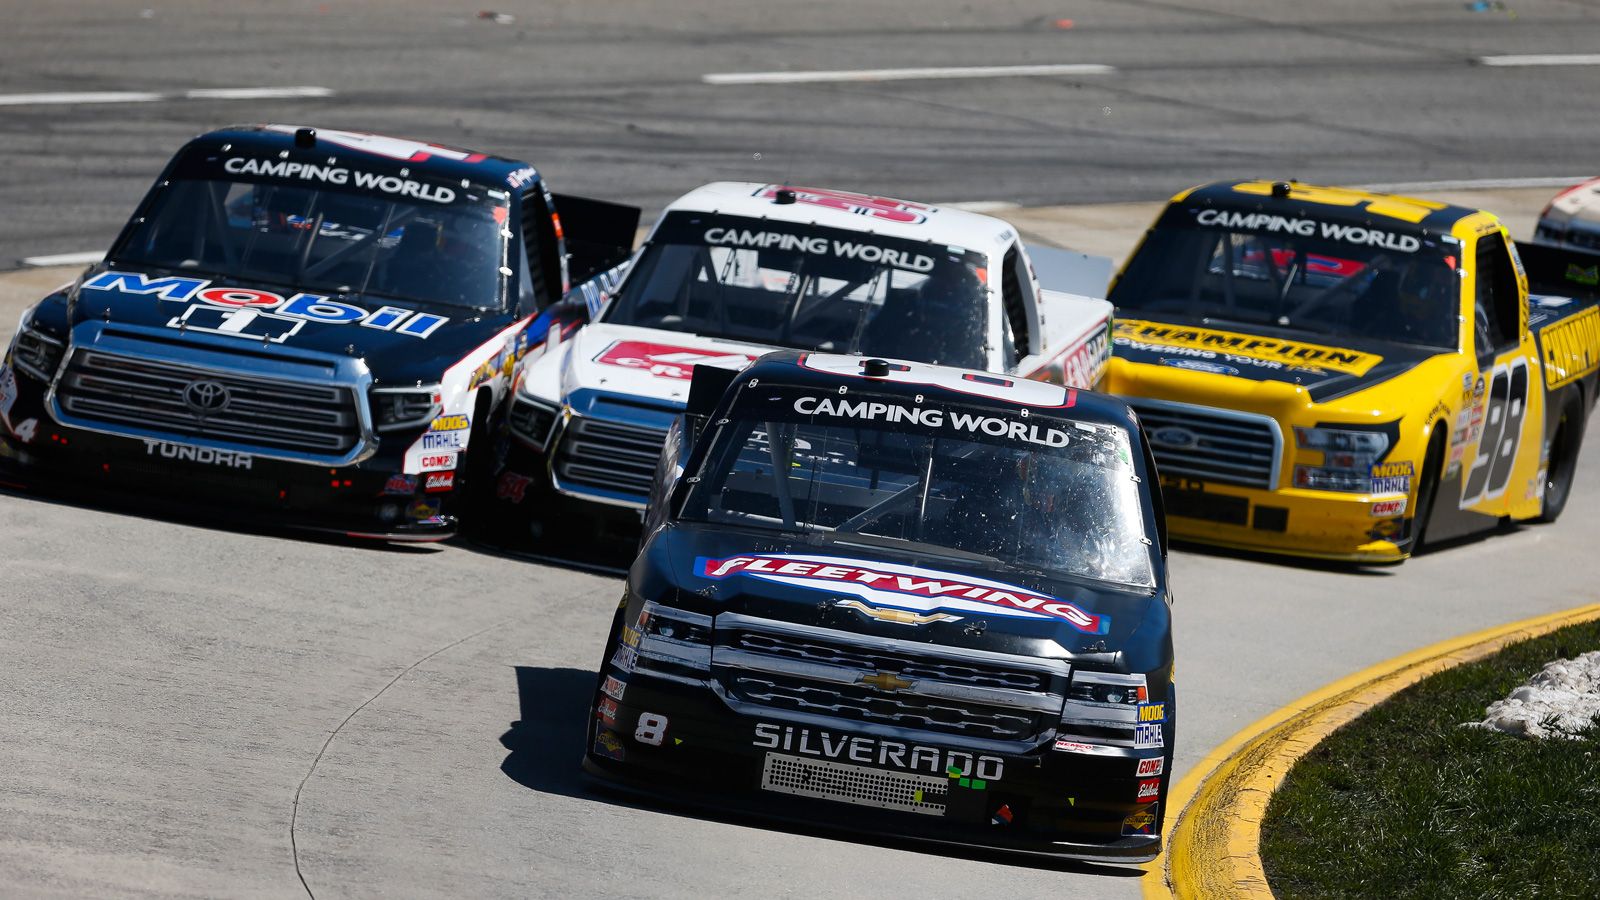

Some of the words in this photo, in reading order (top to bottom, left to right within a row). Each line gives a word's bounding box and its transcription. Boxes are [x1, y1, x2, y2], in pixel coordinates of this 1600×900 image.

[224, 157, 348, 184] CAMPING
[354, 170, 455, 204] WORLD
[1197, 209, 1316, 236] CAMPING
[1321, 222, 1420, 252] WORLD
[704, 227, 828, 254] CAMPING
[833, 240, 935, 271] WORLD
[81, 270, 450, 339] Mobil
[166, 303, 307, 343] 1
[1112, 337, 1217, 359] OWERING
[1225, 353, 1283, 370] YOUR
[14, 417, 38, 443] 4
[793, 396, 943, 427] CAMPING
[949, 411, 1070, 448] WORLD
[1459, 361, 1529, 509] 98
[143, 438, 252, 469] TUNDRA
[423, 432, 460, 449] MAHLE
[1371, 463, 1412, 478] MOOG
[1372, 476, 1409, 494] MAHLE
[711, 557, 1093, 627] FLEETWING
[634, 711, 668, 746] 8
[1139, 704, 1164, 721] MOOG
[1056, 741, 1092, 750] NEMCO
[1135, 723, 1163, 745] MAHLE
[752, 722, 1004, 781] SILVERADO
[1138, 758, 1161, 774] COMP
